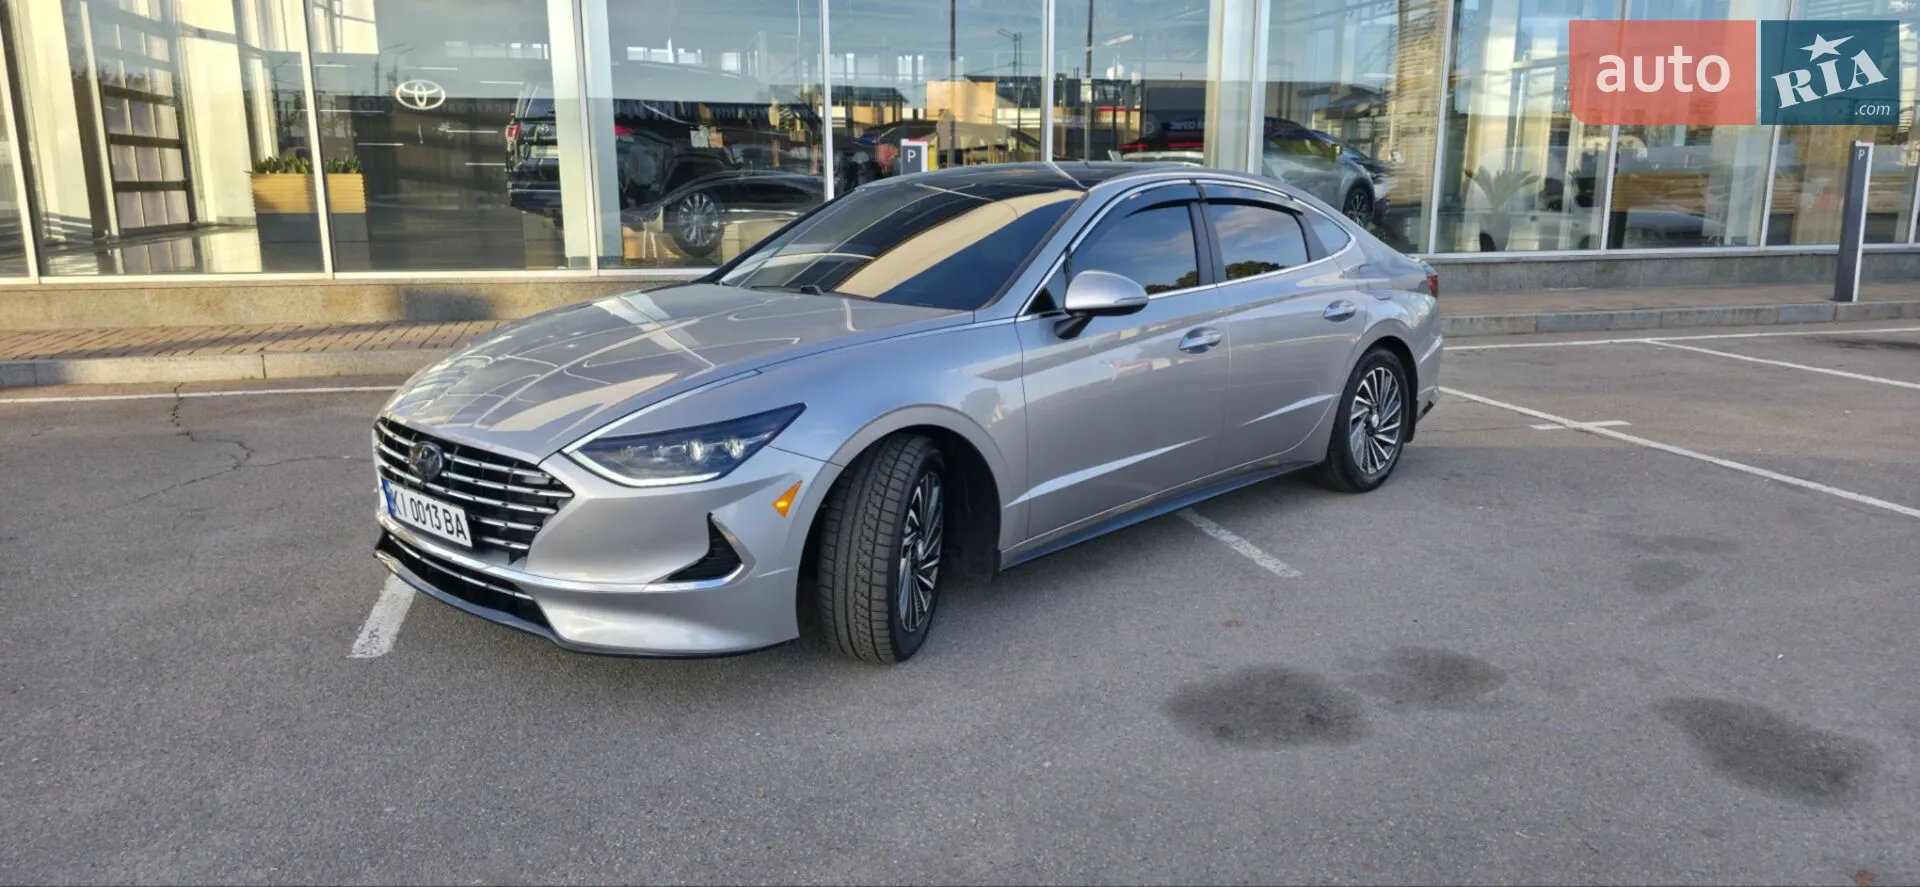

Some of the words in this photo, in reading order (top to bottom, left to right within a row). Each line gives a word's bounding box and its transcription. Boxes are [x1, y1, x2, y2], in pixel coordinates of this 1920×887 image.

[907, 149, 916, 163] P
[1858, 149, 1865, 160] P
[410, 497, 441, 530] 0013
[443, 508, 467, 540] BA
